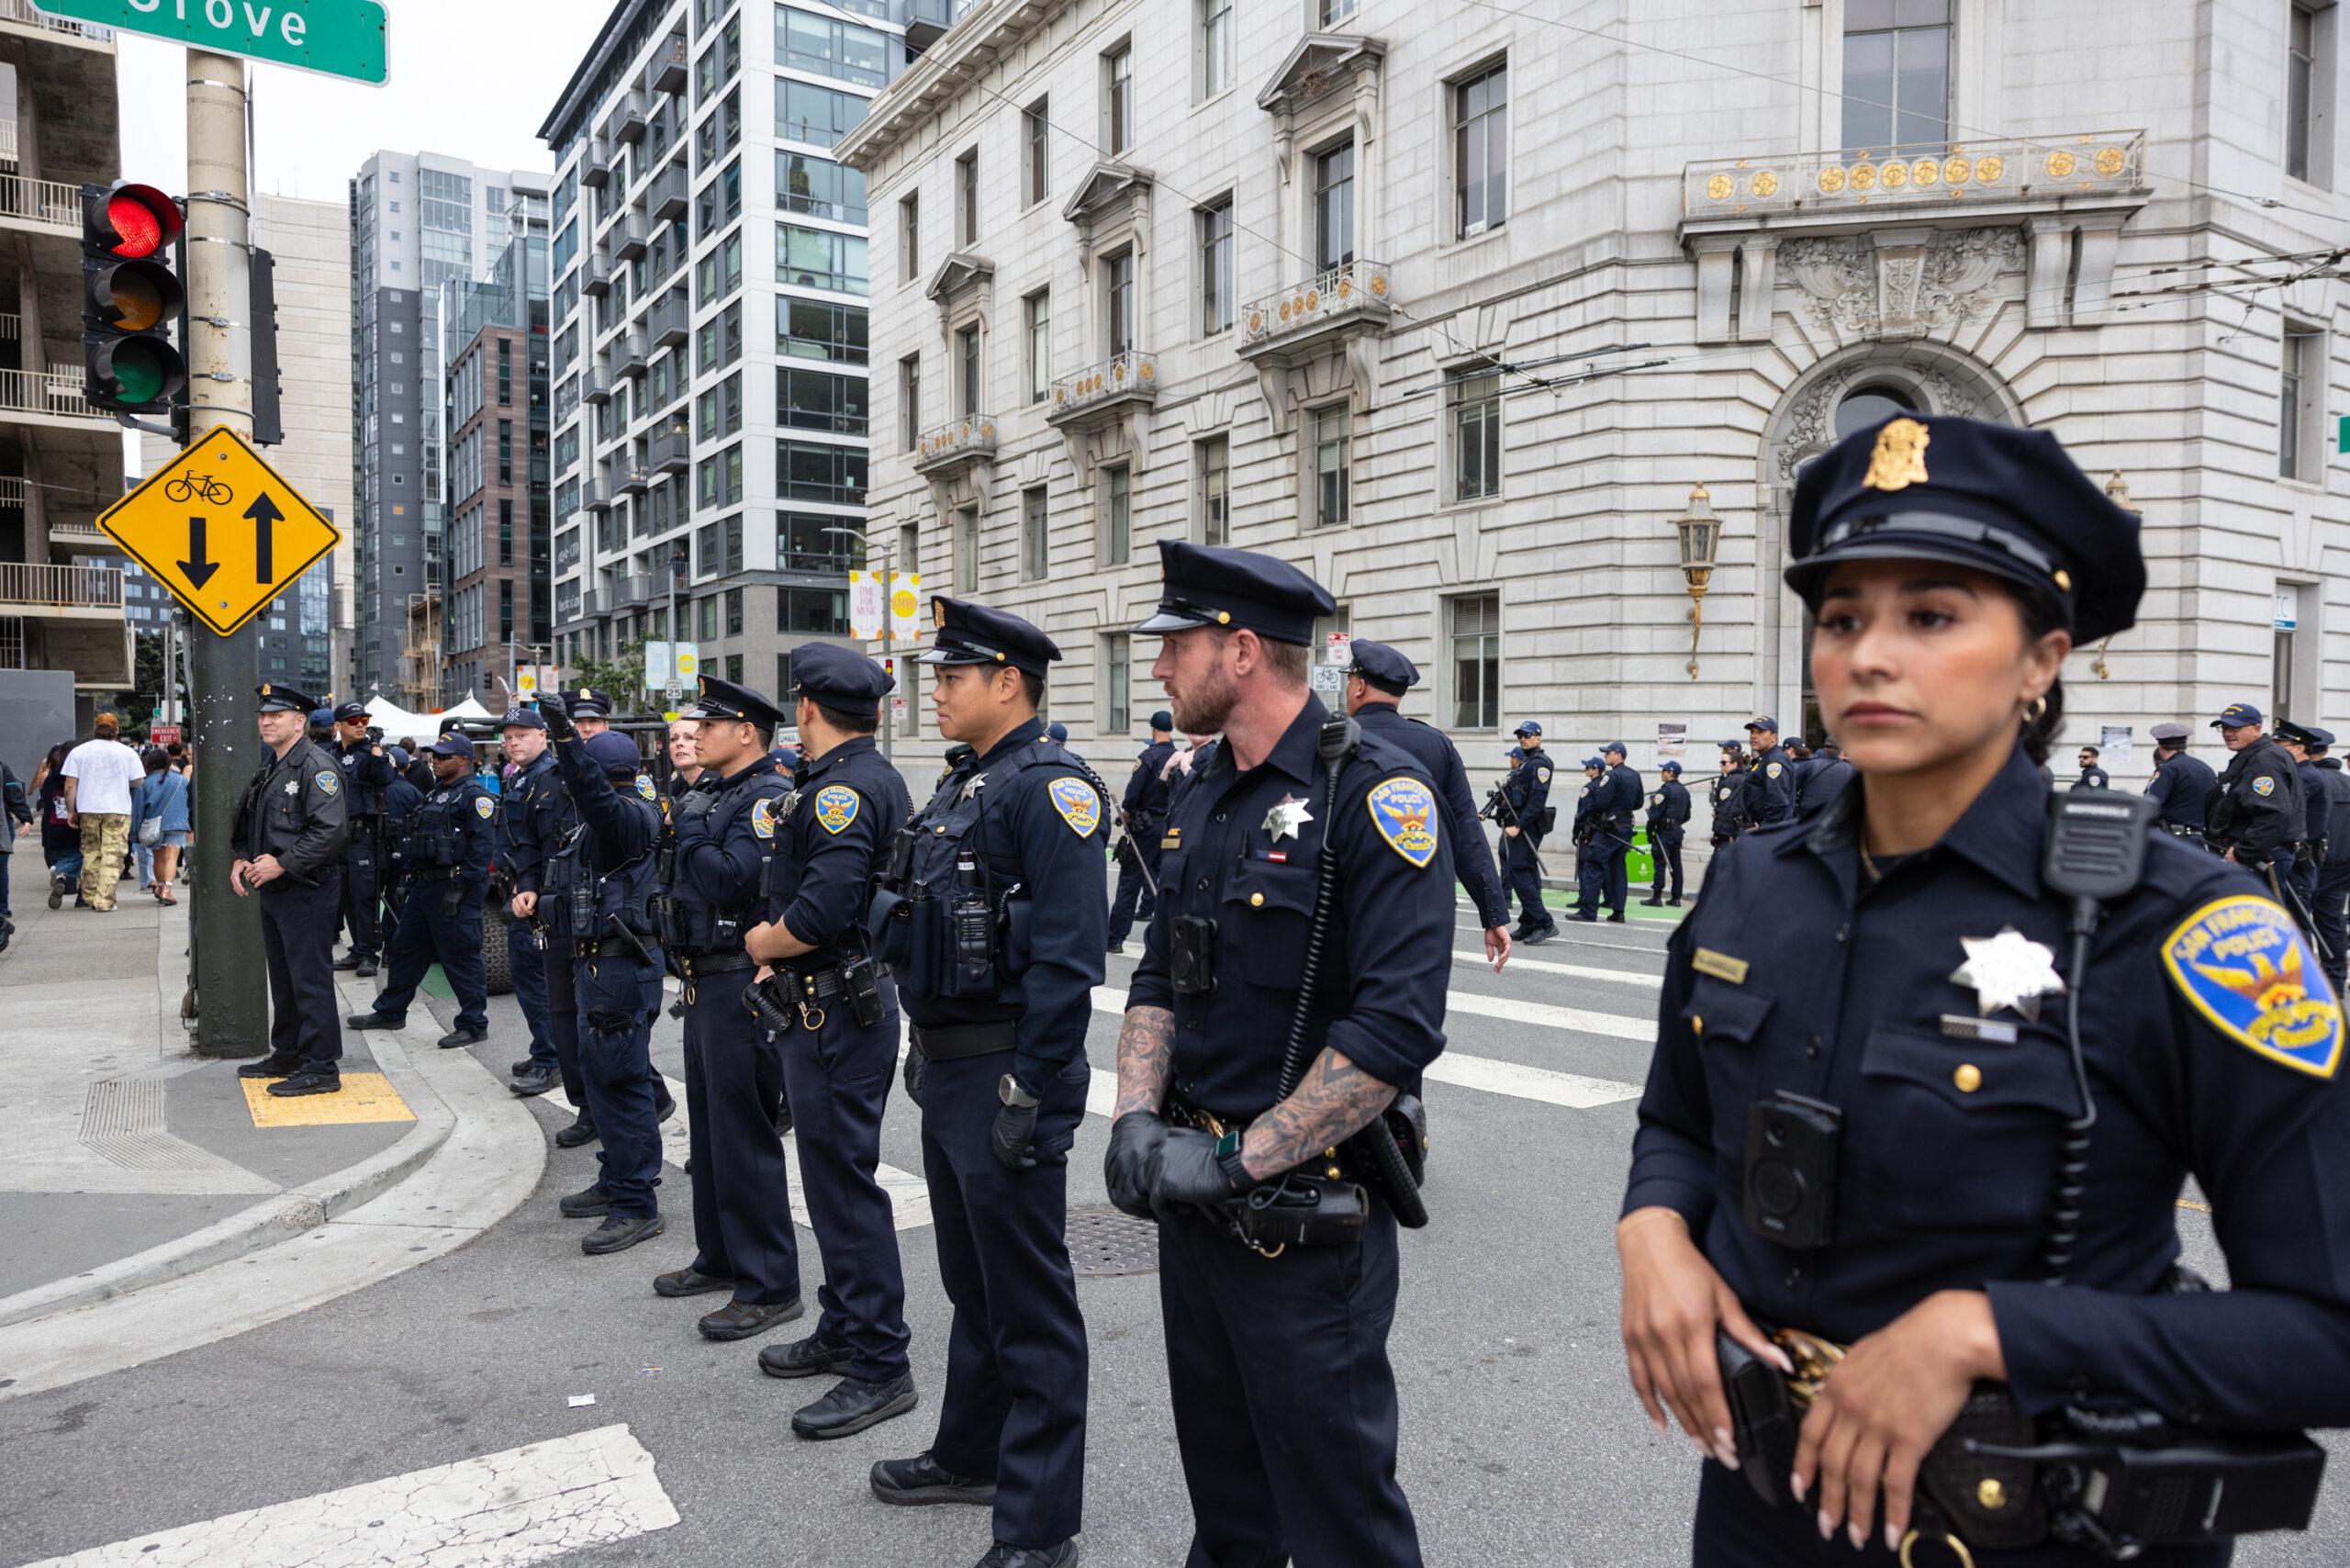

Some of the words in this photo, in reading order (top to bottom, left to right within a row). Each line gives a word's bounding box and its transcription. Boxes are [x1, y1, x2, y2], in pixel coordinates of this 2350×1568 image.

[129, 0, 307, 46] rove
[860, 597, 872, 605] FOR
[1065, 788, 1087, 797] POLICE
[1373, 787, 1392, 803] SAN
[1391, 794, 1422, 804] POLICE
[2174, 926, 2213, 961] SAN
[2213, 926, 2280, 962] POLICE
